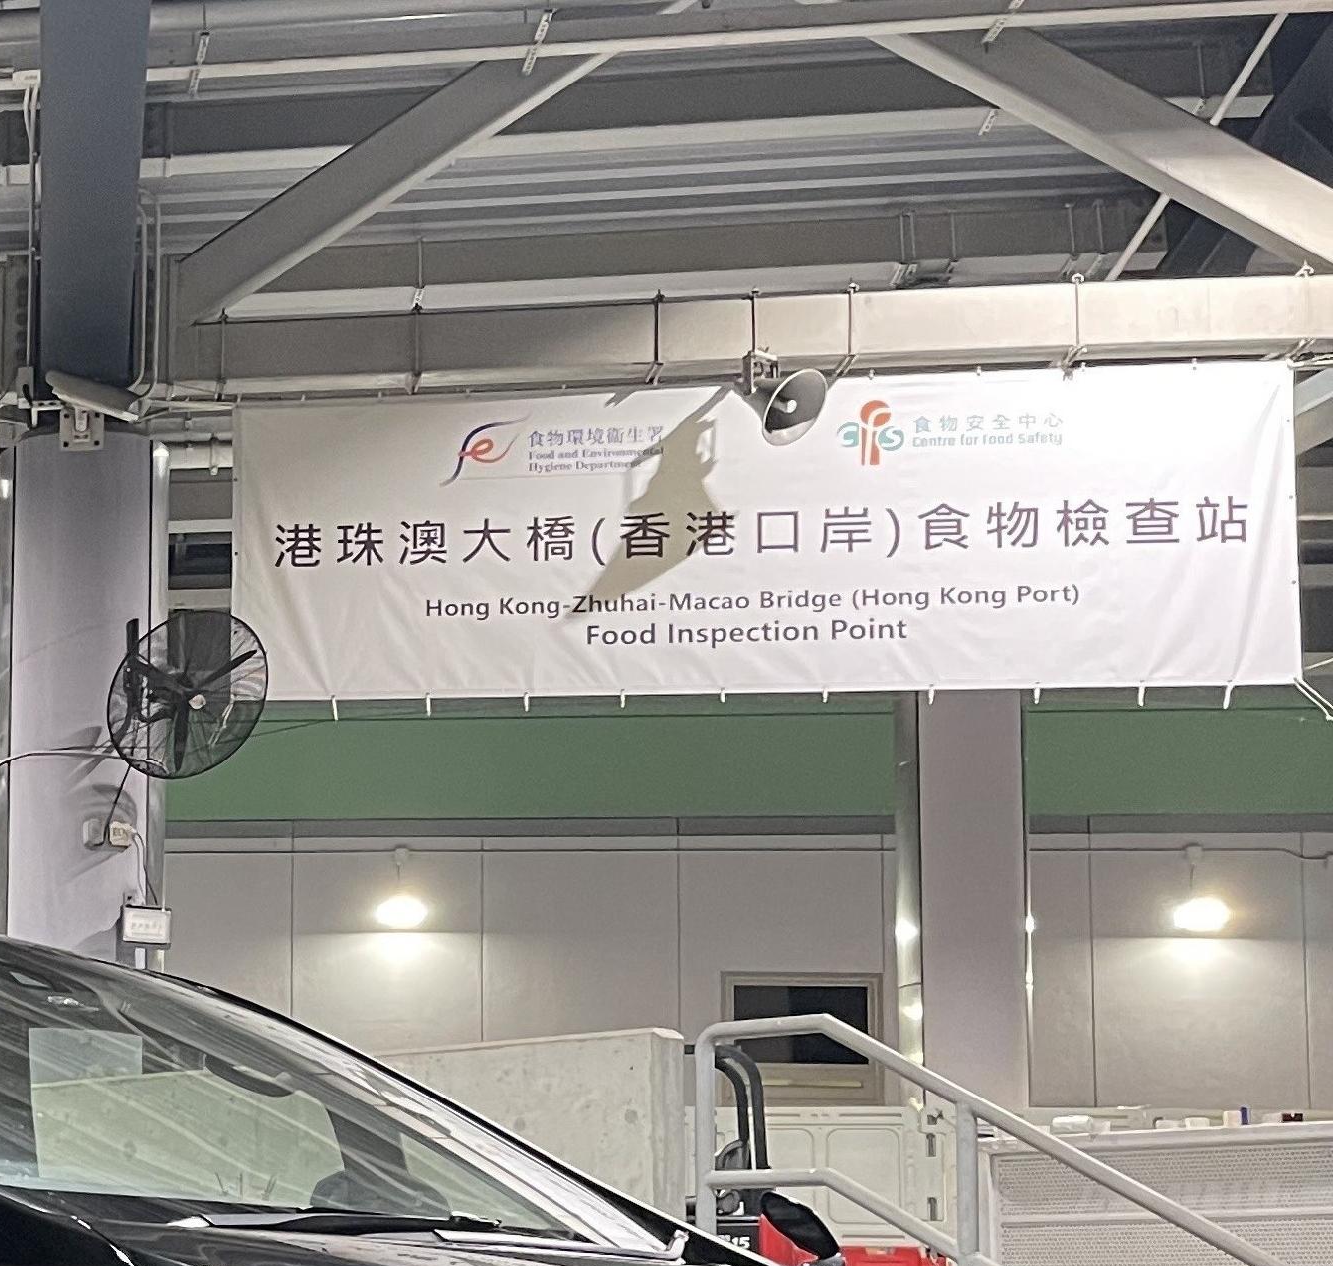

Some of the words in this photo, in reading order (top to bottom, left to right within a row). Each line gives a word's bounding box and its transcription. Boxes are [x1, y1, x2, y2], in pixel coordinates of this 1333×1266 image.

[912, 413, 1063, 433] 食物安全中心
[912, 435, 956, 448] Centre
[960, 433, 979, 446] for
[1018, 430, 1063, 446] Safety
[558, 449, 579, 460] and
[529, 462, 572, 474] Hygiene
[274, 495, 1248, 568] 港珠澳大橋(香港口岸)食物檢查站
[425, 599, 490, 621] Hong
[499, 591, 750, 618] Kong-Zhuhai-Macao
[760, 589, 843, 612] Bridge
[852, 588, 931, 610] (Hong
[940, 586, 1007, 609] Kong
[1017, 583, 1080, 605] Port)
[586, 623, 656, 645] Food
[668, 620, 819, 648] Inspection
[831, 618, 907, 640] Point
